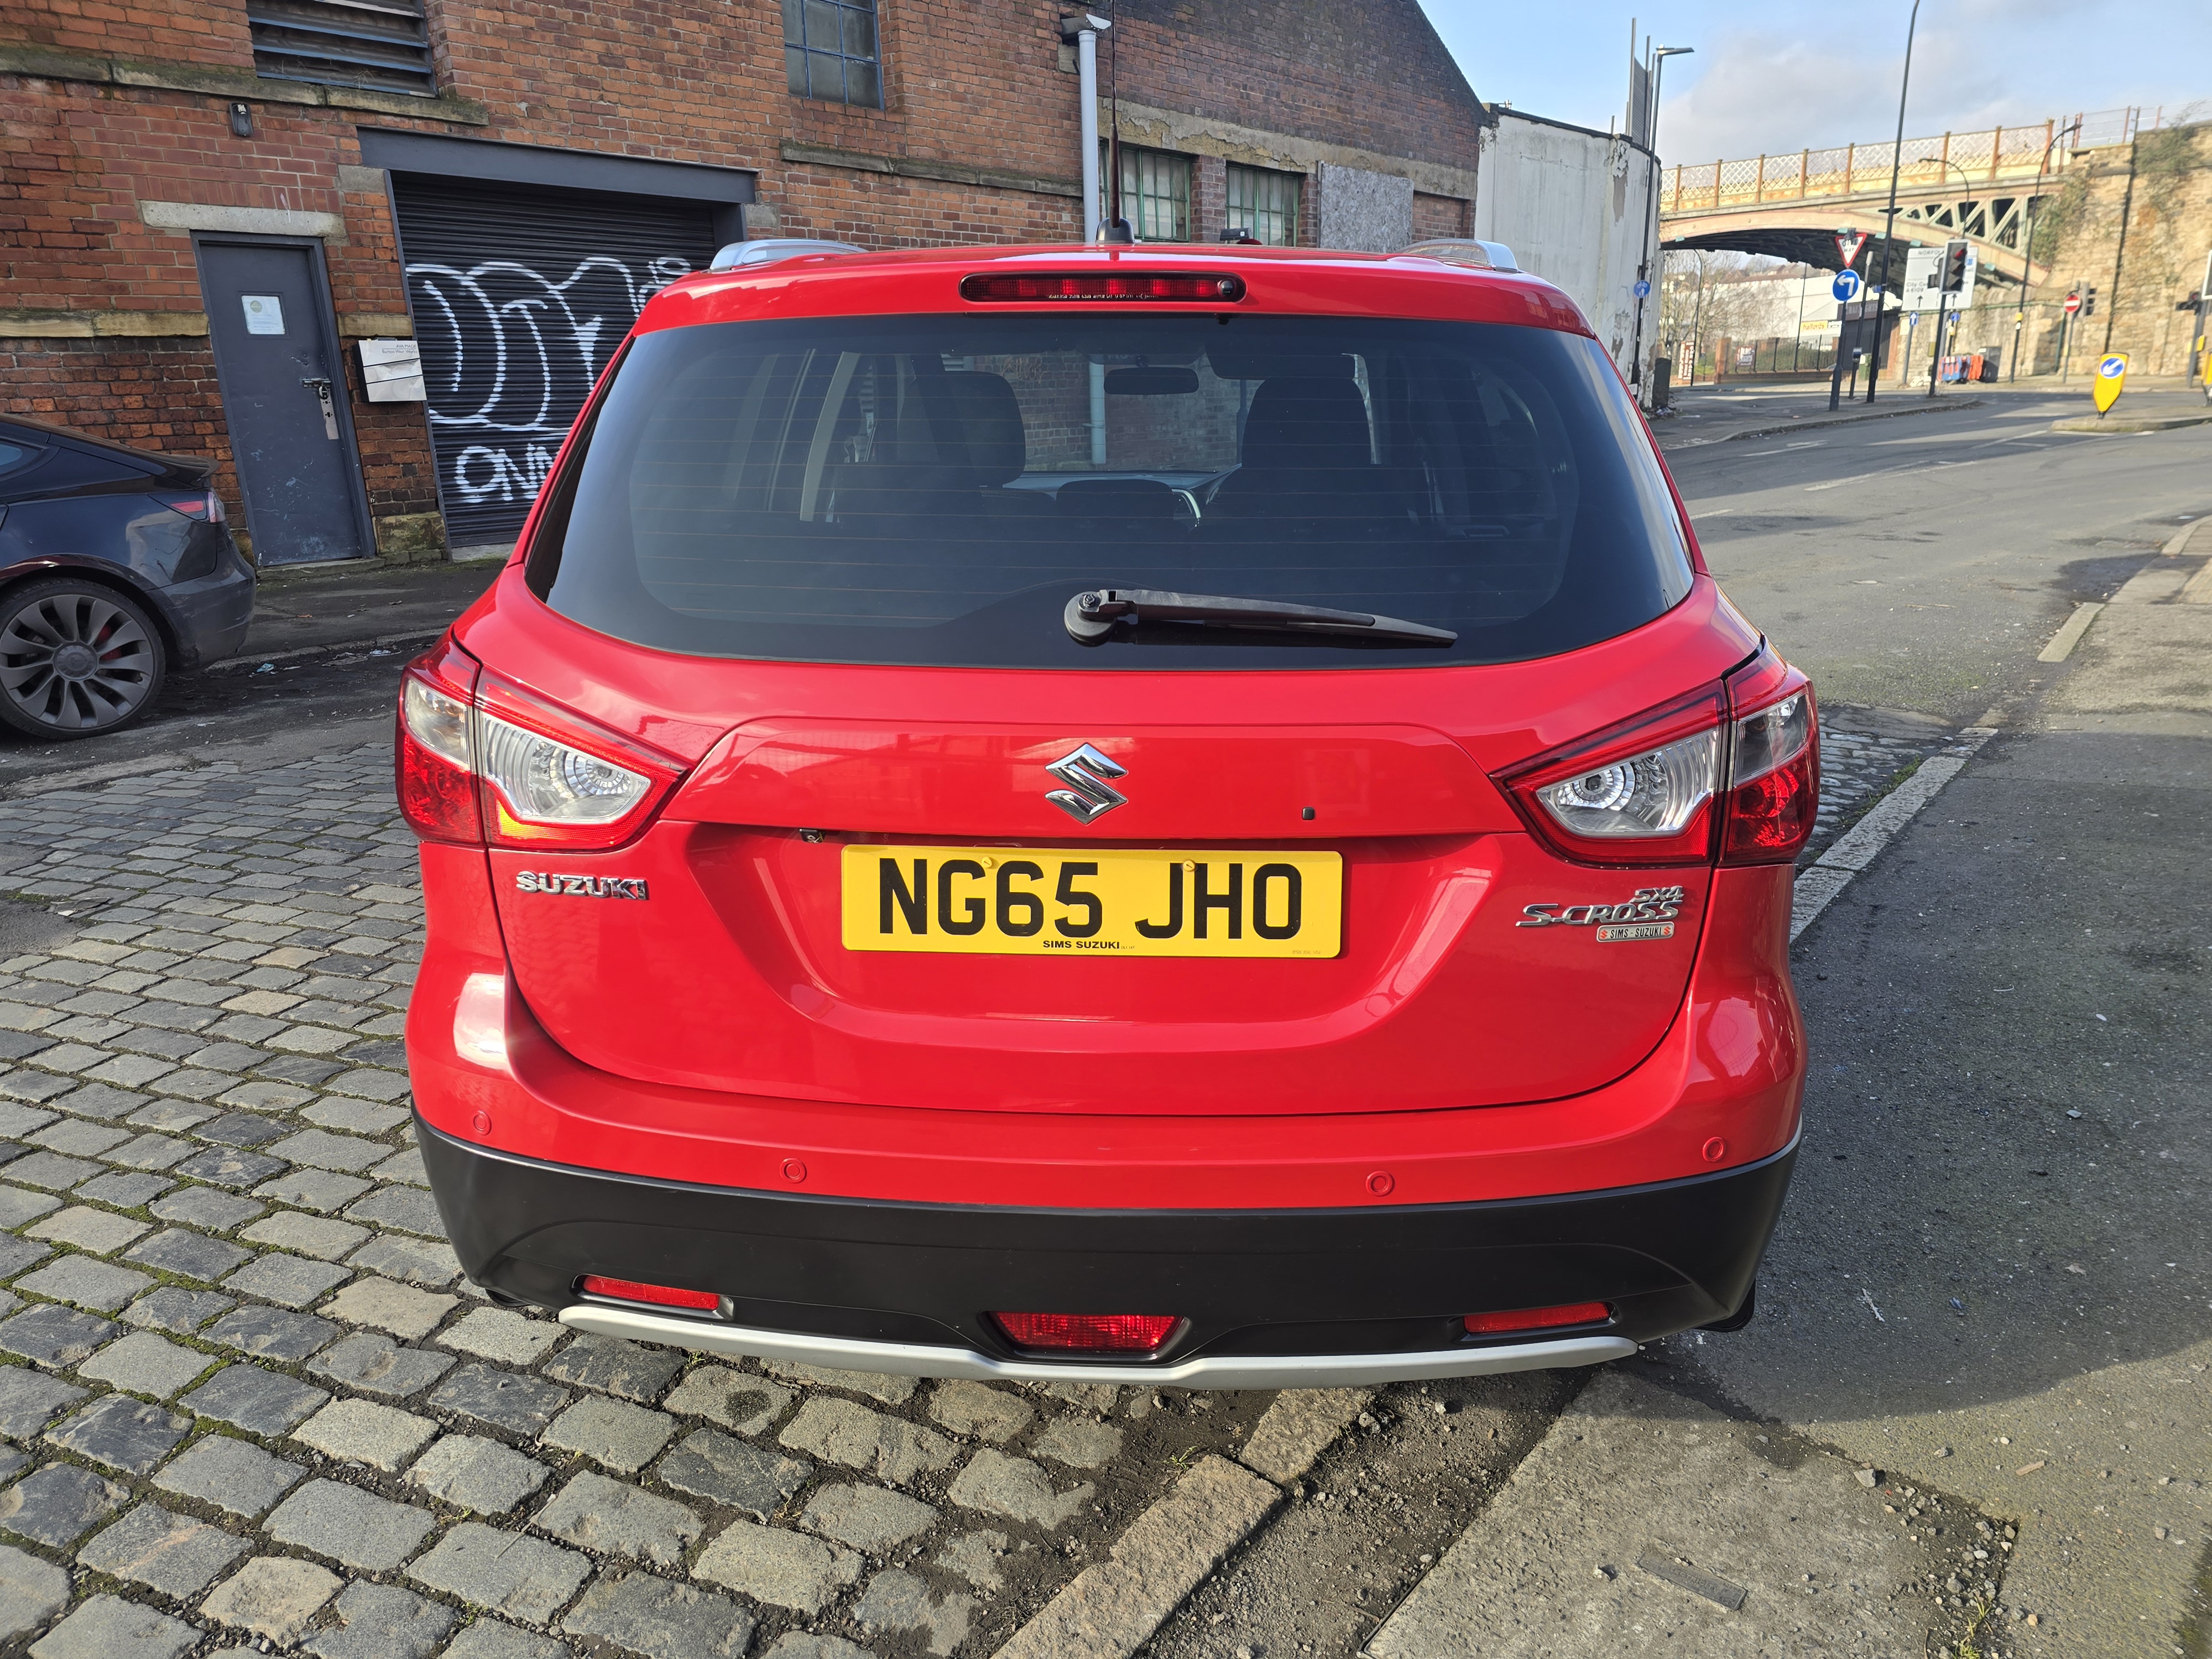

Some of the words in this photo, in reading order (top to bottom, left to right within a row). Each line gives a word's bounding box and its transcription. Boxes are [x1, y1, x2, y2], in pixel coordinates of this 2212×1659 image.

[516, 870, 648, 900] SUZUKI
[1631, 885, 1684, 903] SX4
[879, 858, 1103, 938] NG65
[1135, 863, 1302, 940] JHO
[1610, 928, 1629, 939] SIMS
[1635, 926, 1662, 937] SUZUKI
[1043, 940, 1072, 948] SIMS
[1076, 941, 1120, 949] SUZUKI
